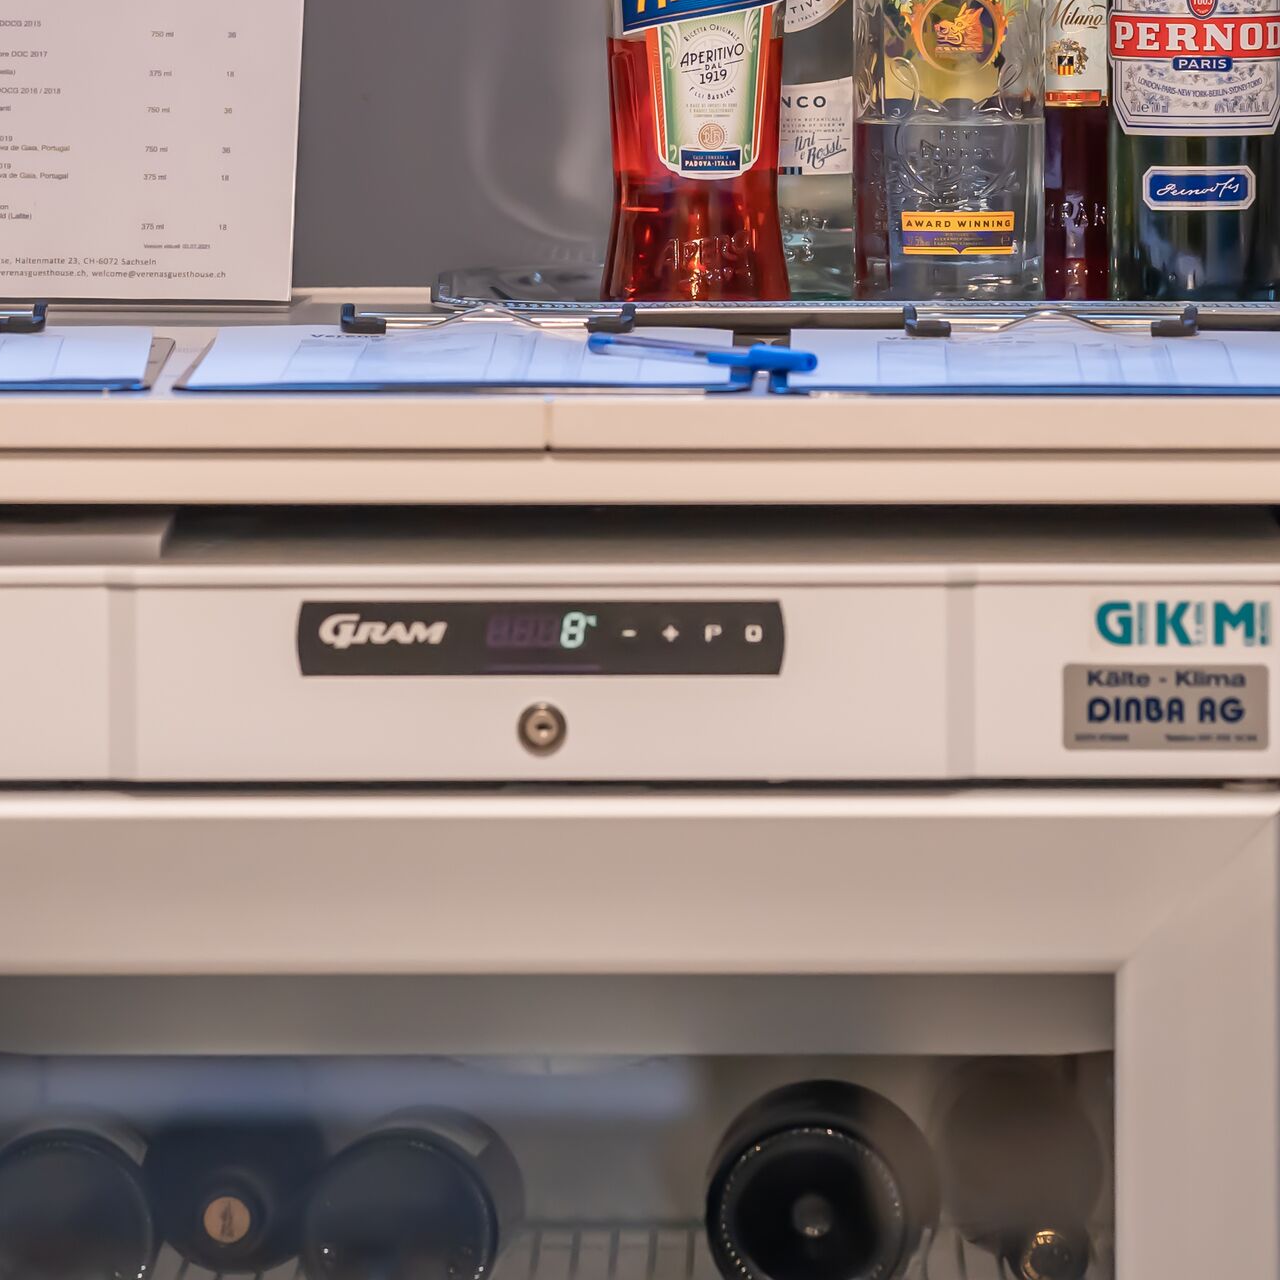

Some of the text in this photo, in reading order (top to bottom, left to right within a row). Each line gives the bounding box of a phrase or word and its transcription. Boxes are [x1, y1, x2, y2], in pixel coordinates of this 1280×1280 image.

[683, 23, 740, 43] RICETTA ORIGINALE
[680, 43, 745, 68] APERITIVO
[704, 63, 722, 71] DAL
[1178, 59, 1227, 69] PARIS
[699, 69, 728, 85] 1919
[707, 86, 737, 100] BARBIERI
[781, 96, 827, 108] NCO
[905, 219, 1012, 228] AWARD WINNING
[15, 257, 65, 265] Haltenmatte
[68, 257, 80, 265] 23,
[121, 258, 157, 266] Sachseln
[92, 270, 226, 279] welcome@verenasguesthouse.ch
[319, 613, 448, 649] GRAM
[1087, 670, 1151, 688] Kälte
[1175, 670, 1247, 688] Klima
[1087, 696, 1246, 723] DINBA AG
